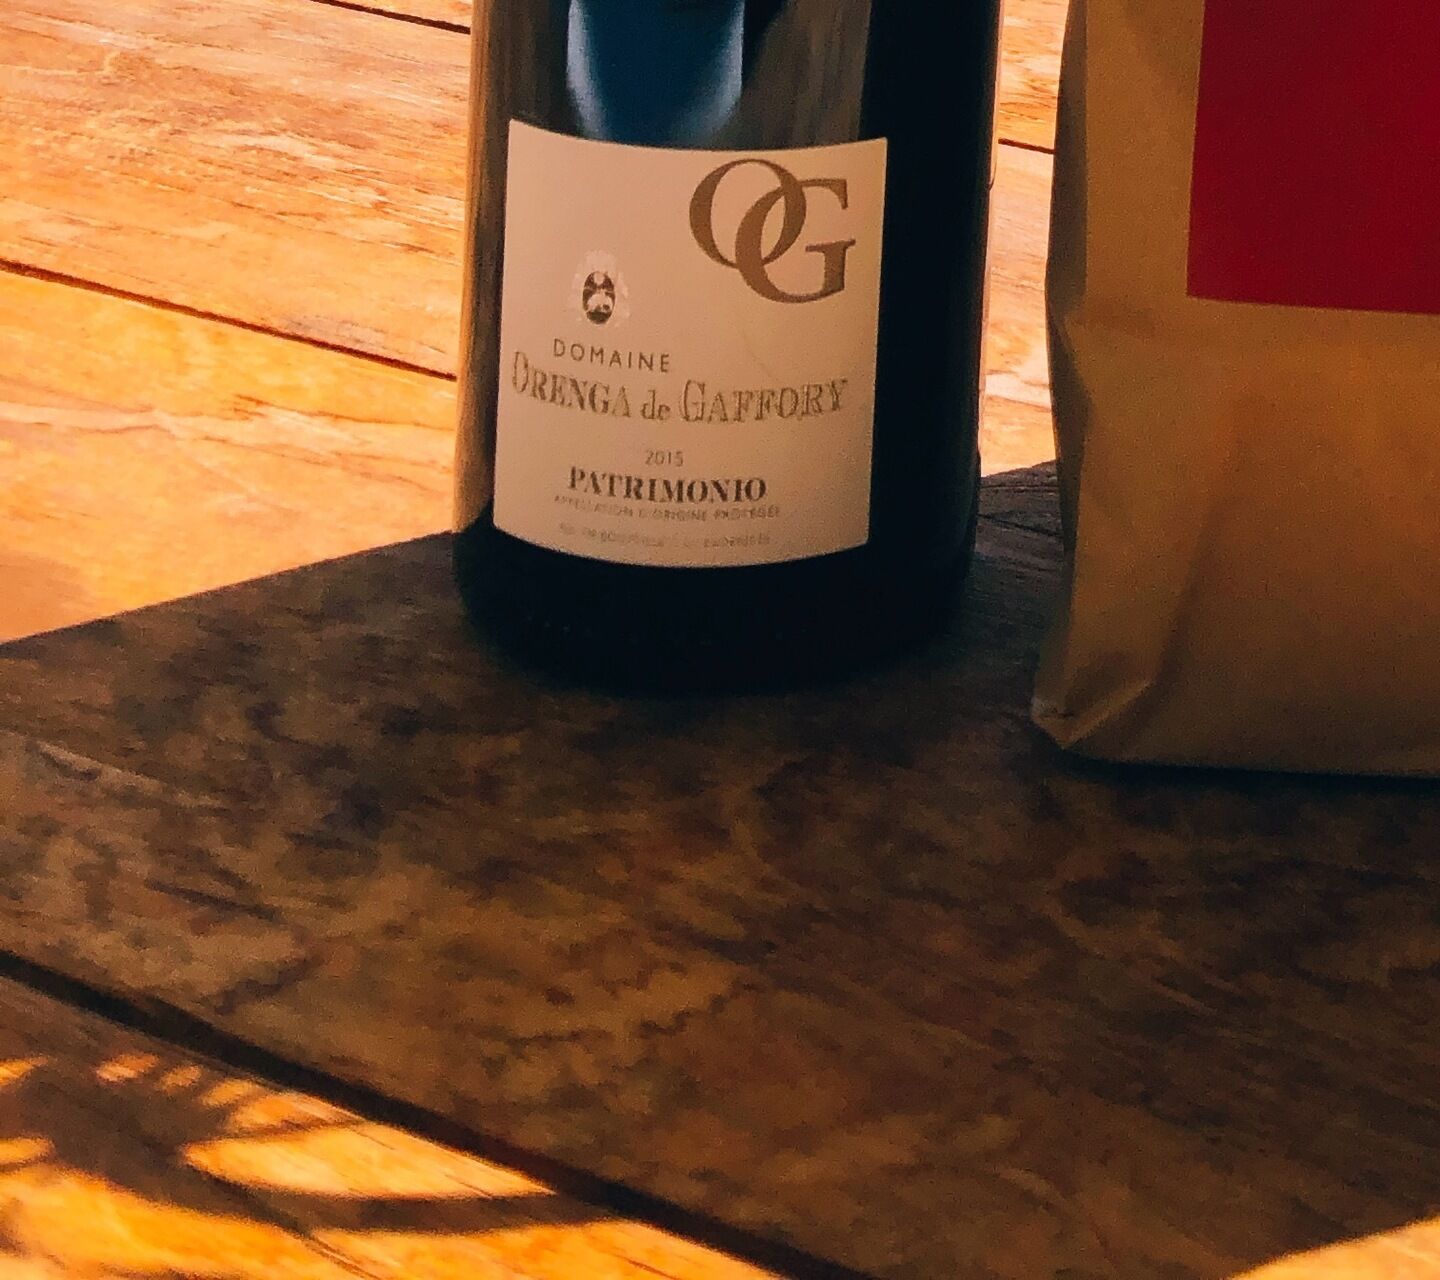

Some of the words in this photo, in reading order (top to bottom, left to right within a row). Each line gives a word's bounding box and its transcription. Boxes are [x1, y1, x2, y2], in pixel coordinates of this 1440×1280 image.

[689, 158, 857, 304] OG
[553, 338, 672, 373] DOMAINE
[511, 350, 633, 419] ORENGA
[639, 388, 671, 422] de
[682, 377, 849, 424] GAFFORY
[644, 450, 685, 468] 2015
[569, 465, 767, 504] PATRIMONIO
